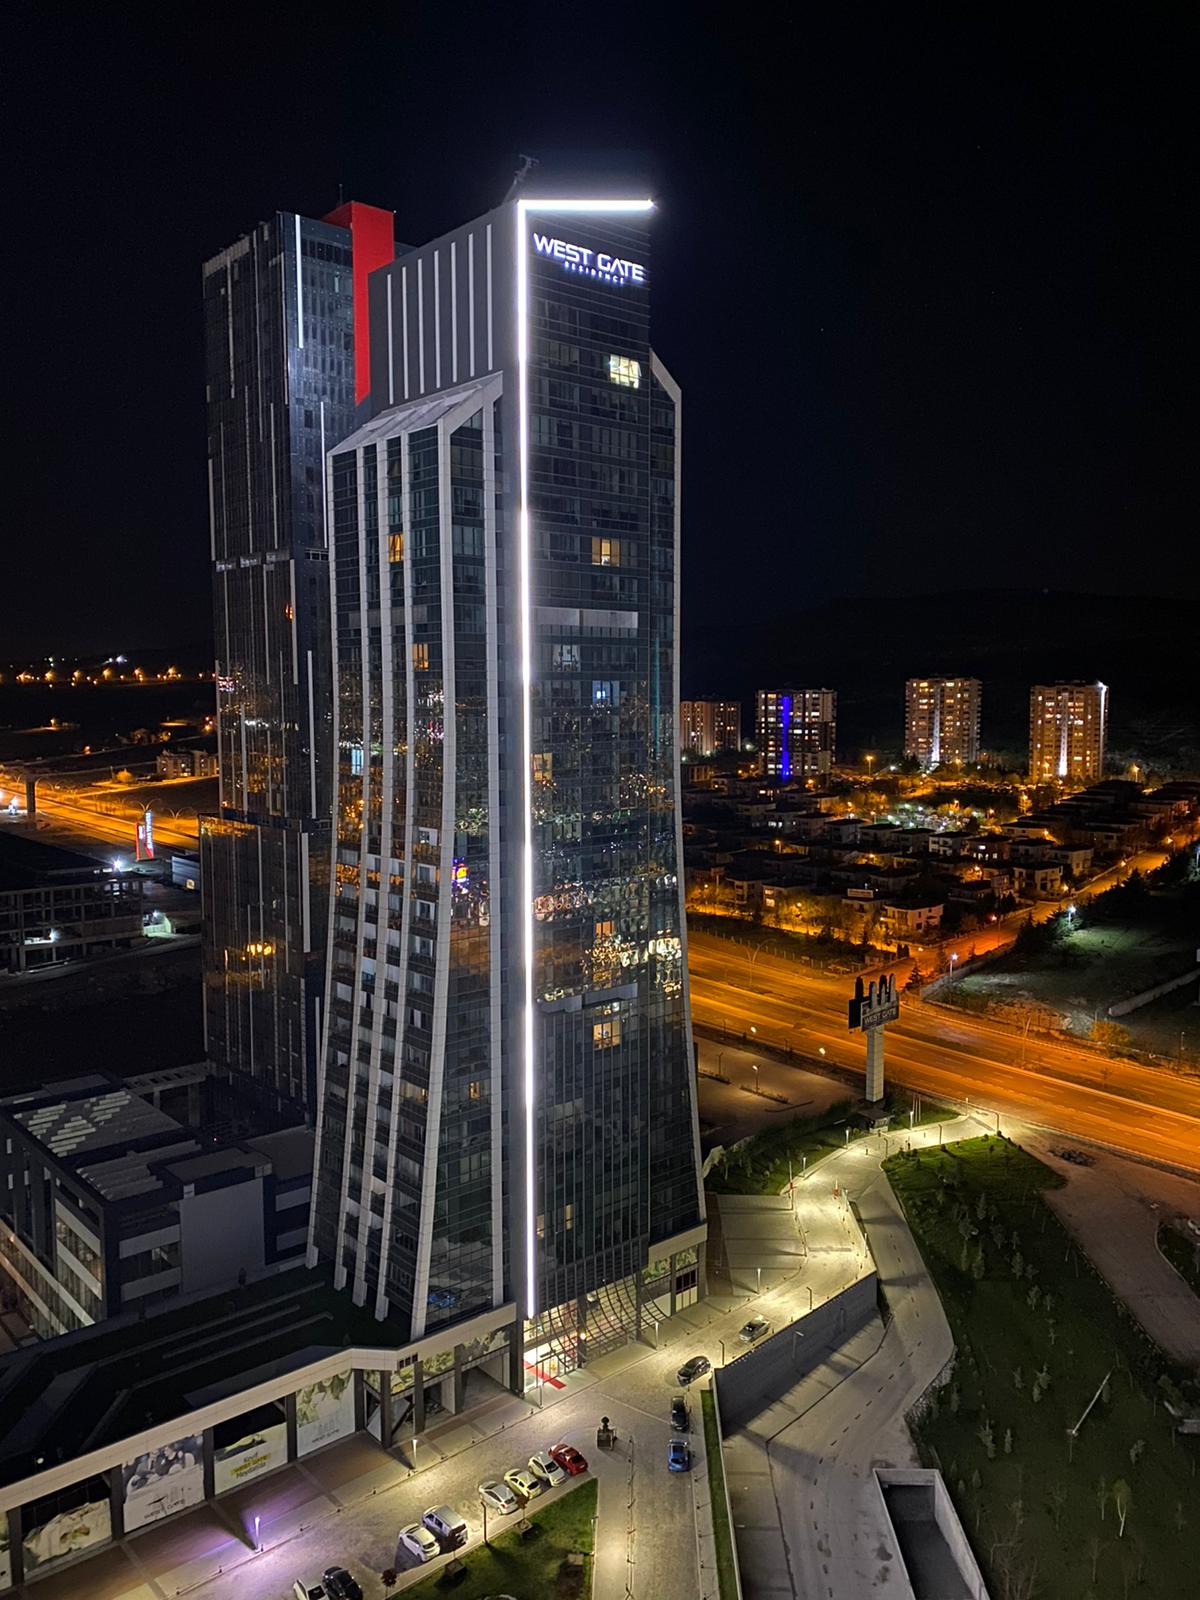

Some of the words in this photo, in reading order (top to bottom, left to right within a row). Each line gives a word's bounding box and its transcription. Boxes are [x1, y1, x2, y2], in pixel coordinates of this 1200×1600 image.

[532, 232, 593, 265] WEST
[597, 252, 645, 281] GATE
[564, 261, 625, 285] RESIDENCE
[864, 1013, 880, 1024] WEST
[881, 1008, 897, 1018] GATE
